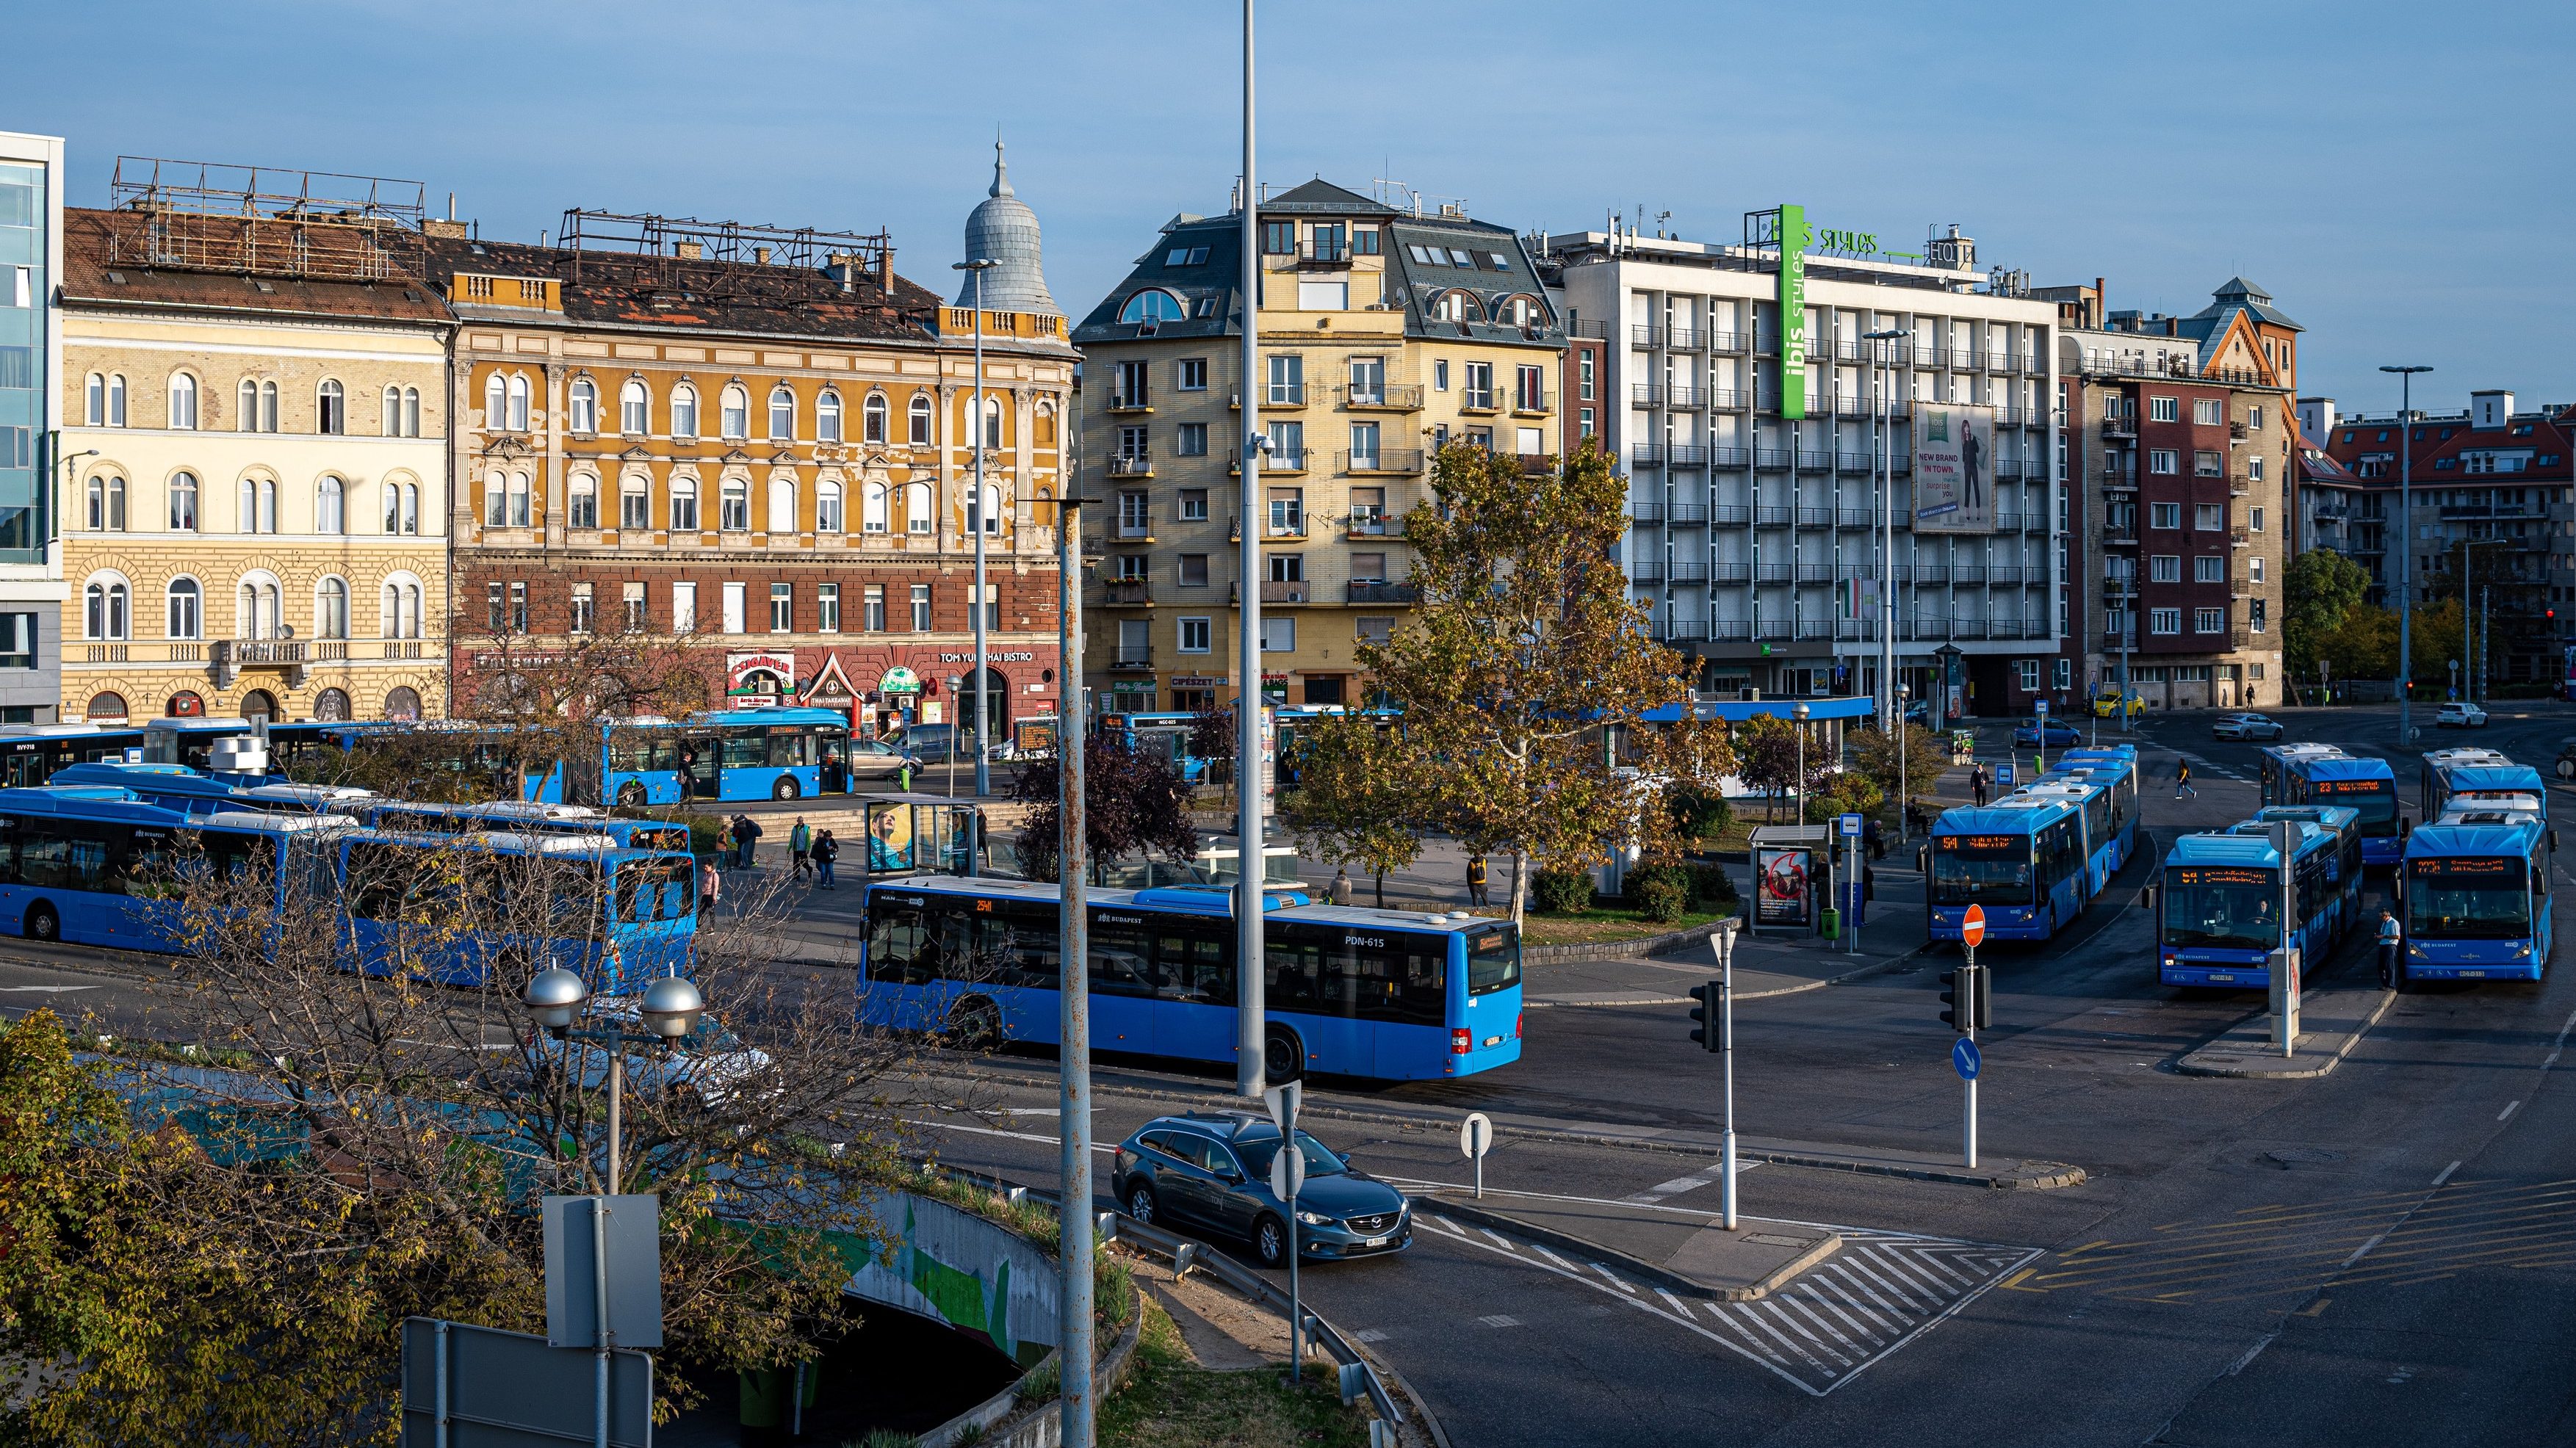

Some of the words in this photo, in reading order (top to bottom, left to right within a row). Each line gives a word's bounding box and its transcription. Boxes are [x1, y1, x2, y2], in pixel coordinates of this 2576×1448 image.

[1930, 241, 1980, 264] HOTEL
[1786, 327, 1804, 376] ibis
[1932, 416, 1944, 426] ibis
[1919, 453, 1934, 462] NEW
[1935, 454, 1958, 462] BRAND
[1933, 466, 1954, 474] TOWN
[1926, 482, 1950, 490] surprise
[941, 654, 959, 662] TOM
[1004, 652, 1033, 661] BISTRO
[732, 656, 790, 675] CSIGAVÉR
[1172, 676, 1213, 686] CIPÉSZET
[977, 900, 992, 912] 254M
[1345, 935, 1385, 947] PDN-615
